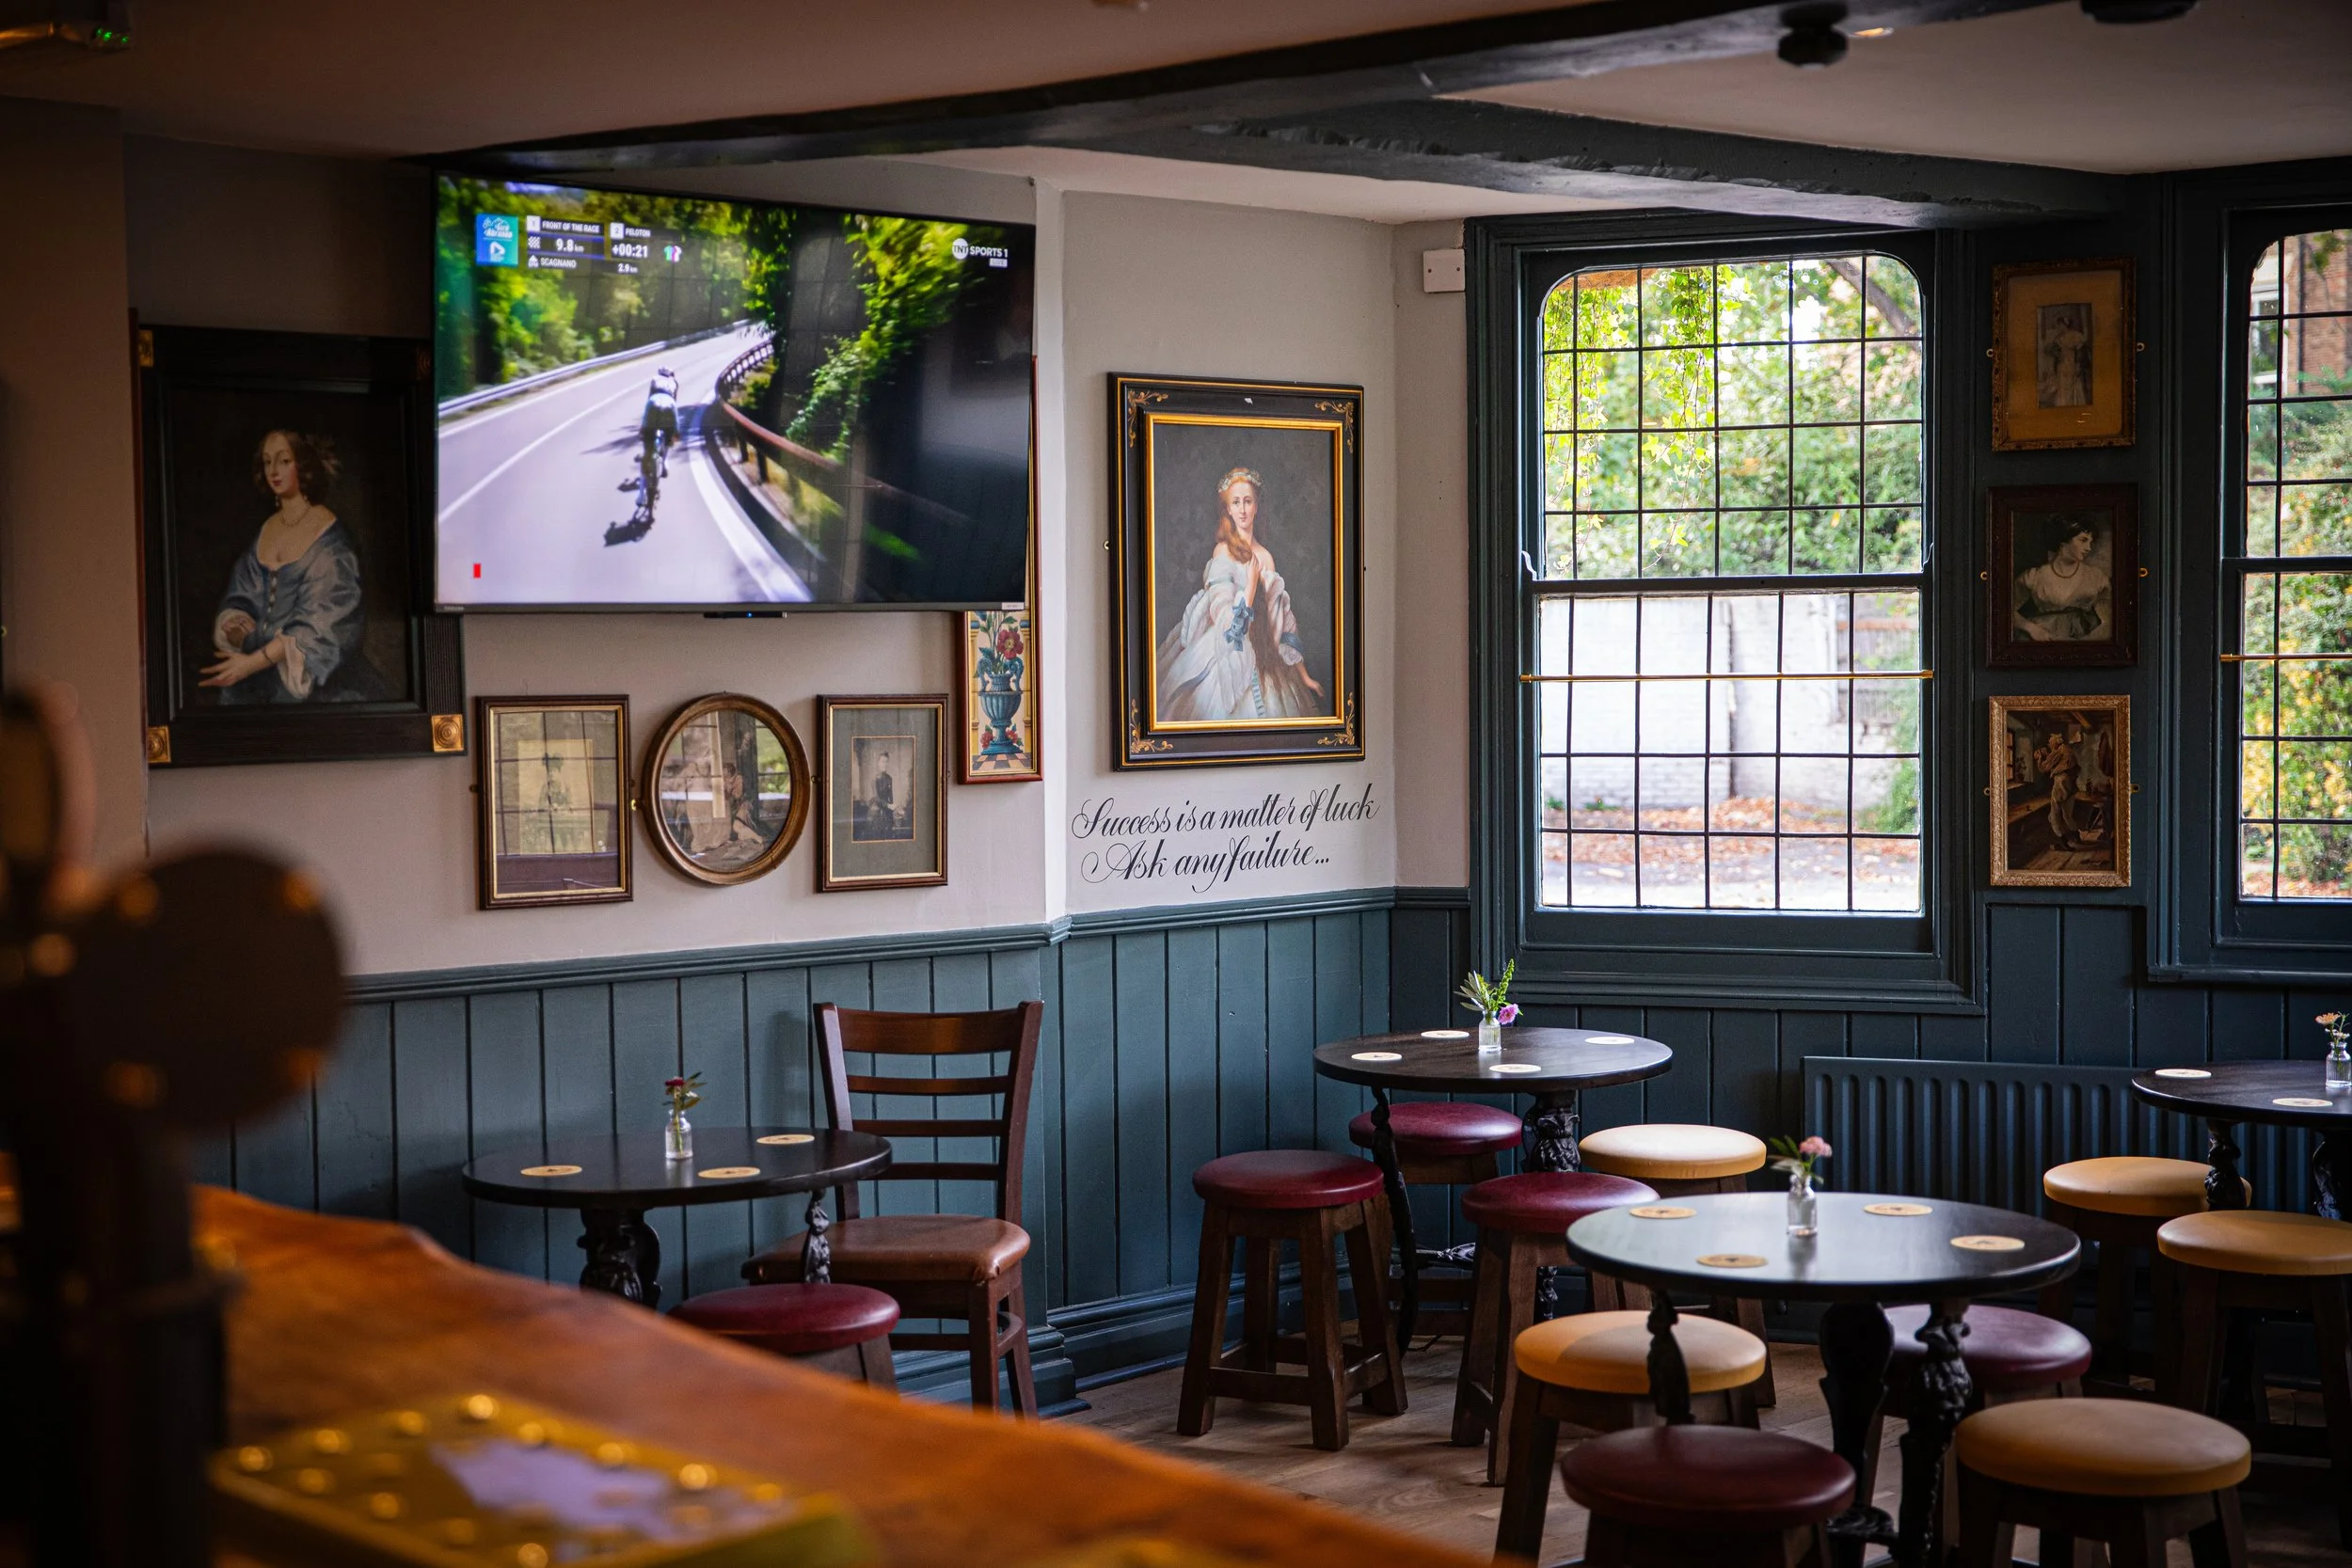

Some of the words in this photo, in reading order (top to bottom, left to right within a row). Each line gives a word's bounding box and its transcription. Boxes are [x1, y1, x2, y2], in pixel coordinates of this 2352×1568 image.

[542, 220, 562, 230] FRONT
[563, 222, 569, 230] OF
[572, 223, 582, 231] THE
[583, 225, 600, 233] RACE
[626, 228, 651, 237] PELOTON
[556, 238, 574, 253] 9.8
[575, 244, 584, 253] km
[612, 243, 648, 259] +00:21
[970, 245, 1003, 258] SPORTS
[1003, 248, 1009, 258] 1
[540, 258, 577, 269] SCAGNANO
[618, 262, 630, 273] 2.9
[1072, 797, 1170, 839] Success
[1176, 800, 1198, 832] is
[1200, 811, 1216, 831] a
[1219, 794, 1296, 830] matter
[1299, 788, 1328, 832] of
[1326, 783, 1380, 822] luck
[1081, 838, 1169, 884] Ask
[1174, 848, 1226, 894] any
